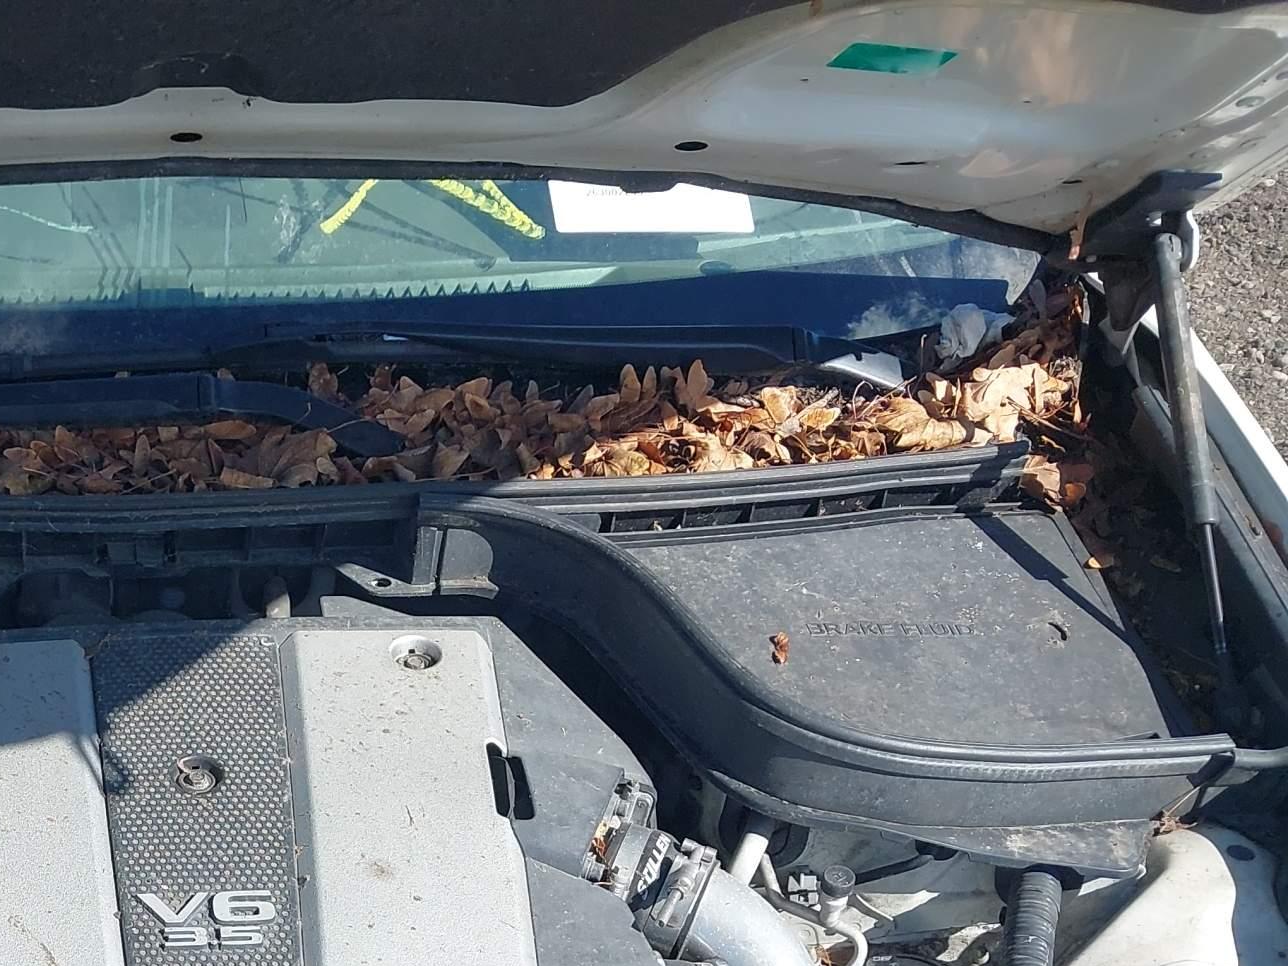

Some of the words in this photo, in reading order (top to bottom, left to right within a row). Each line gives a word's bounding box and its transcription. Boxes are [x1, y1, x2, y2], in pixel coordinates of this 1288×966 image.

[805, 622, 893, 636] BRAKE
[901, 622, 974, 636] FLUID
[137, 890, 276, 925] V6
